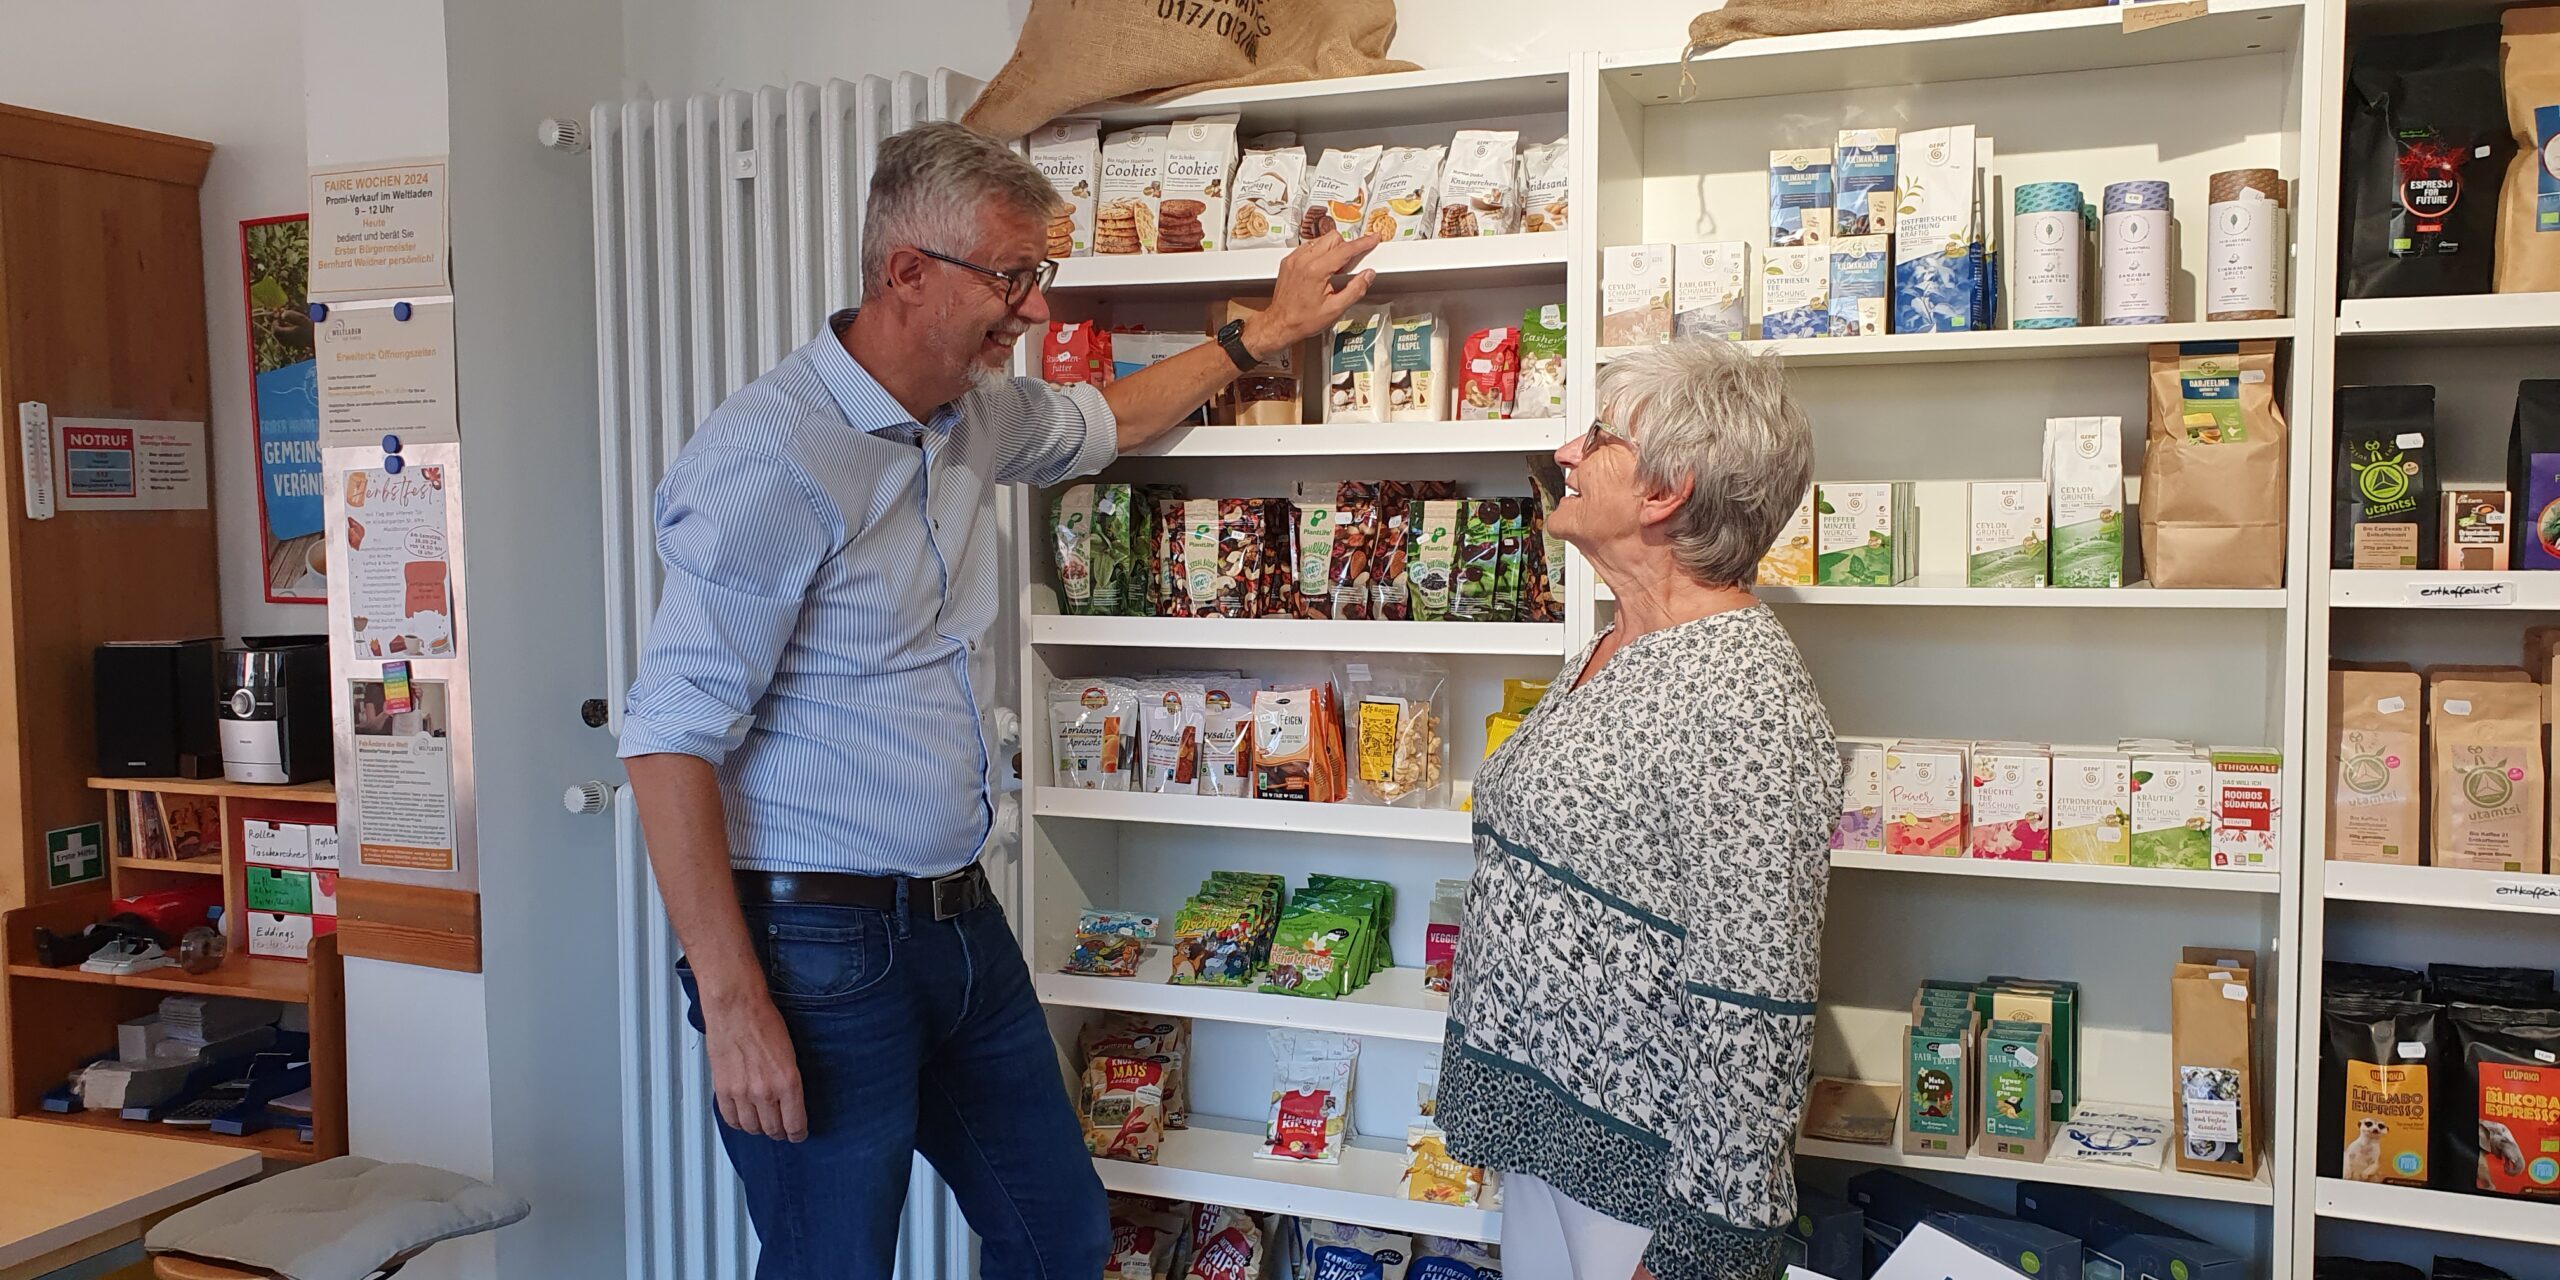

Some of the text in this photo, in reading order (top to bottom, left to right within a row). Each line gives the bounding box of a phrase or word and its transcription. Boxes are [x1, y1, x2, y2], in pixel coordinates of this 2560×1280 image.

[1105, 165, 1157, 177] Cookies
[1168, 162, 1219, 175] Cookies
[325, 173, 429, 192] FAIRE WOCHEN 2024
[1316, 179, 1341, 191] Taler
[1379, 179, 1408, 191] Herzen
[1450, 177, 1498, 187] Knusperchen
[1529, 177, 1567, 191] eidesand
[2410, 180, 2454, 190] ESPRESSO
[326, 189, 433, 205] Promi-Verkauf im Weltladen
[2424, 188, 2440, 197] FOR
[2416, 196, 2448, 205] FUTURE
[354, 205, 394, 216] 9 12 Uhr
[363, 219, 386, 228] Heute
[1900, 222, 1940, 231] MISCHUNG
[1901, 215, 1958, 226] OSTFRIESISCHE
[337, 233, 363, 243] bedient
[364, 232, 378, 241] und
[401, 229, 414, 238] Sie
[1767, 290, 1806, 298] MISCHUNG
[1397, 333, 1420, 342] KOKOS-
[1397, 342, 1421, 351] RASPEL
[2189, 378, 2230, 388] DARJEELING
[70, 434, 128, 446] NOTRUF
[2365, 497, 2416, 516] utamtsi
[1151, 729, 1180, 744] Physalis
[2217, 764, 2277, 772] ETHIQUABLE
[1889, 786, 1934, 804] Power
[1978, 788, 2013, 796] FRÜCHTE
[2224, 791, 2263, 800] ROOIBOS
[2349, 790, 2398, 806] utamtsi
[2058, 798, 2117, 807] ZITRONENGRAS
[2137, 794, 2174, 803] KRÄUTER
[1978, 801, 2020, 810] MISCHUNG
[2224, 800, 2268, 810] SÜDAFRIKA
[2137, 808, 2180, 817] MISCHUNG
[2468, 804, 2521, 821] utamtsi
[255, 926, 295, 942] Eddings
[1431, 932, 1458, 944] VEGGIE
[1914, 1053, 1931, 1061] FAIR
[1989, 1055, 2006, 1063] FAIR
[1113, 1065, 1147, 1079] MAIS
[2503, 1070, 2540, 1082] WÜPAKA
[2352, 1088, 2424, 1104] LITEMBO
[2485, 1089, 2560, 1109] BUKOBA
[2352, 1100, 2424, 1119] ESPRESSO
[2485, 1104, 2560, 1124] ESPRESSO
[1206, 1245, 1239, 1280] CHIPS
[1325, 1251, 1367, 1270] KARTOFFEL
[1198, 1260, 1219, 1279] ROT
